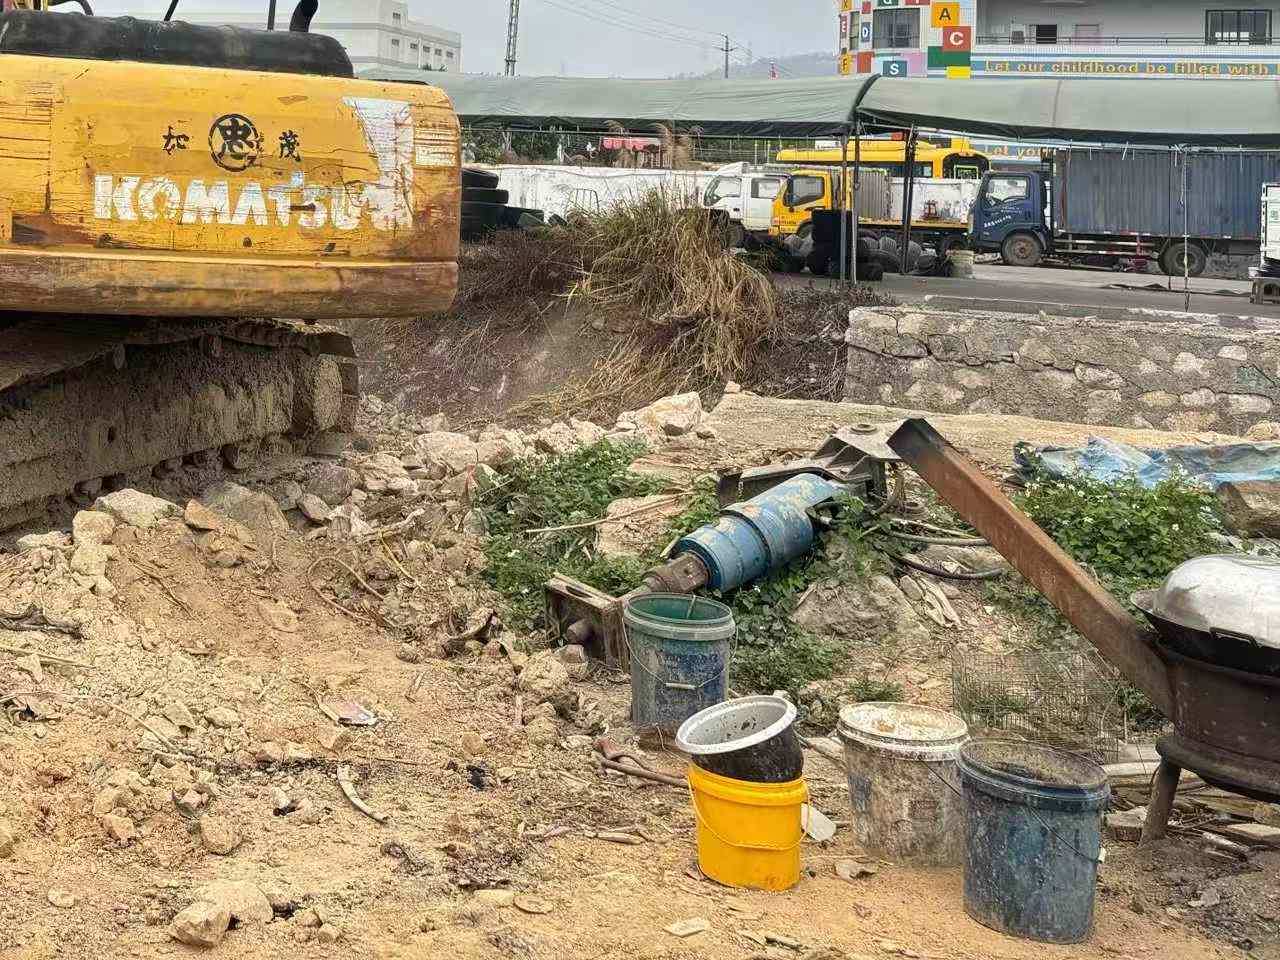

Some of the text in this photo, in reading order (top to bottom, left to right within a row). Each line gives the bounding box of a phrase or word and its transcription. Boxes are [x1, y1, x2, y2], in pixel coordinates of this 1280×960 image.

[939, 7, 951, 21] A
[862, 27, 869, 38] D
[949, 31, 964, 46] C
[889, 63, 900, 75] S
[984, 60, 1009, 73] Let
[1017, 62, 1044, 73] our
[1051, 60, 1138, 74] childhood
[1146, 61, 1167, 74] be
[1174, 61, 1220, 75] filled
[1228, 62, 1268, 75] with
